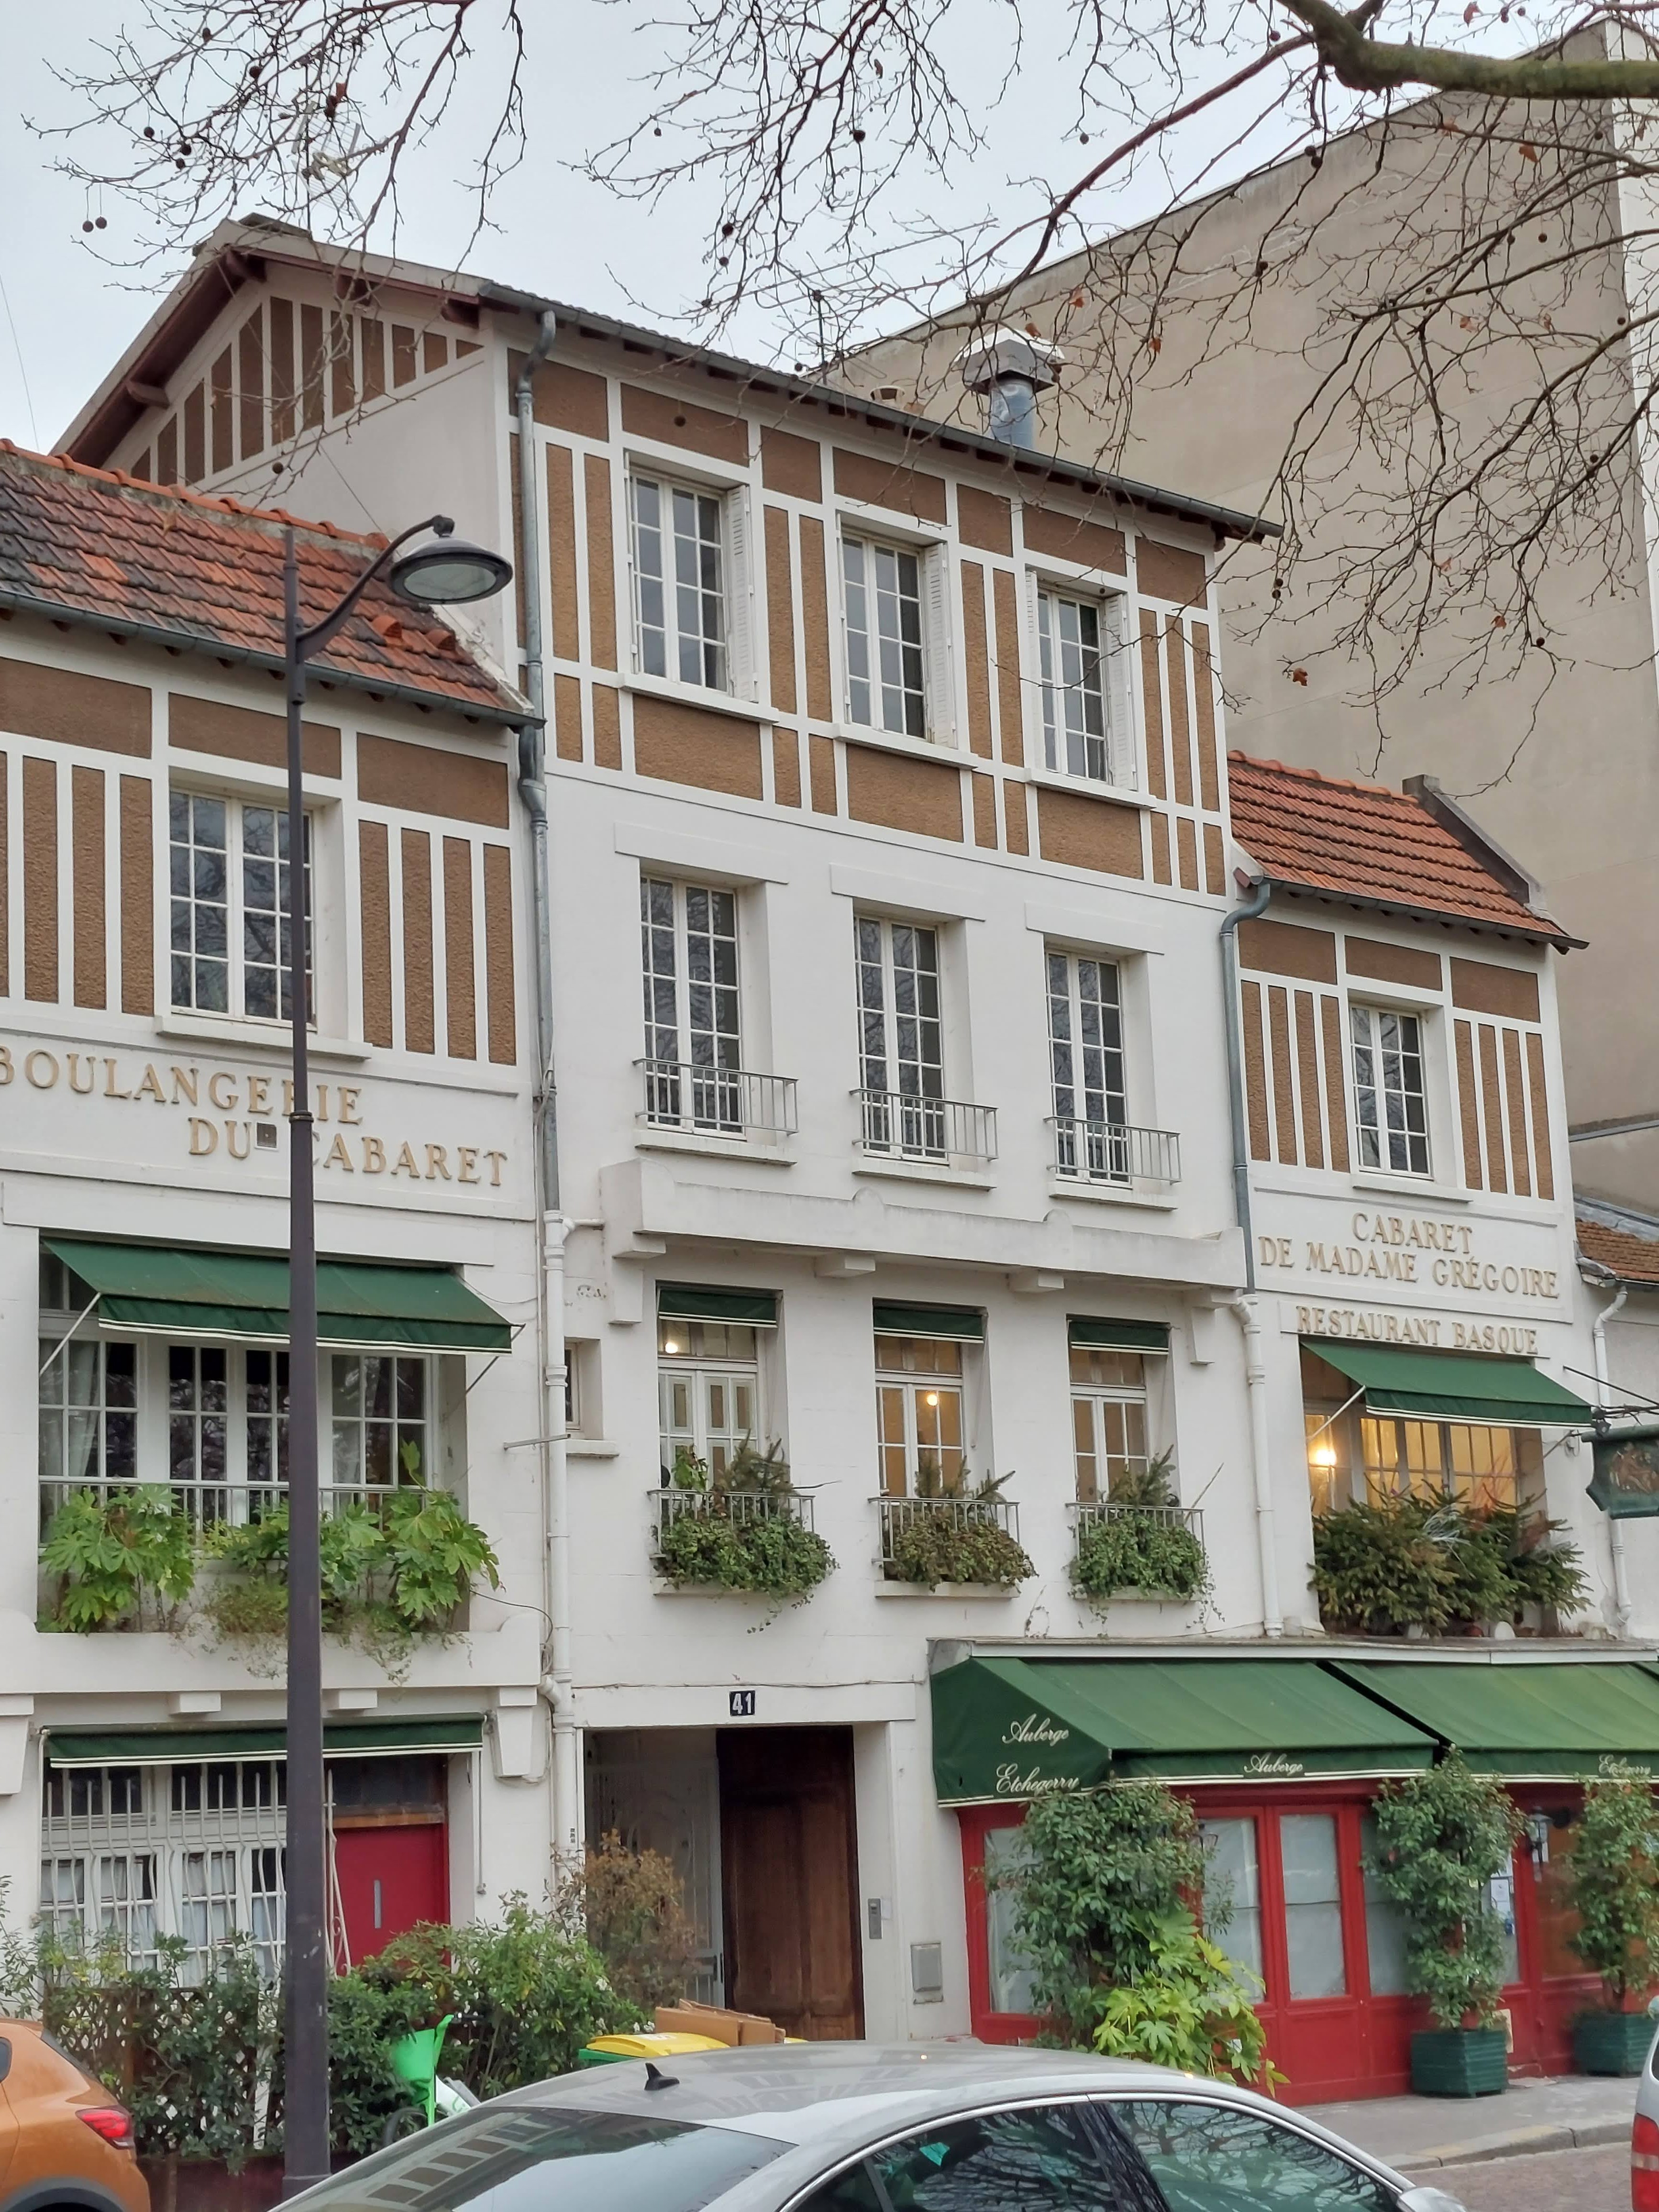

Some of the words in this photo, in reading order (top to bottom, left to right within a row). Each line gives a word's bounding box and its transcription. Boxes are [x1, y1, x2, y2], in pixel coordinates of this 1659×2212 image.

[188, 1117, 252, 1161] DU
[311, 1130, 508, 1186] ABARET
[1352, 1212, 1473, 1254] CABARET
[1258, 1236, 1294, 1268] DE
[1305, 1241, 1419, 1283] MADAME
[1432, 1256, 1559, 1299] GRÉGOIRE
[1296, 1305, 1441, 1345] RESTAURANT
[1451, 1322, 1538, 1355] BASQUE
[732, 1692, 752, 1714] 41
[1002, 1713, 1070, 1747] Auberge
[1244, 1752, 1304, 1776] Auberge
